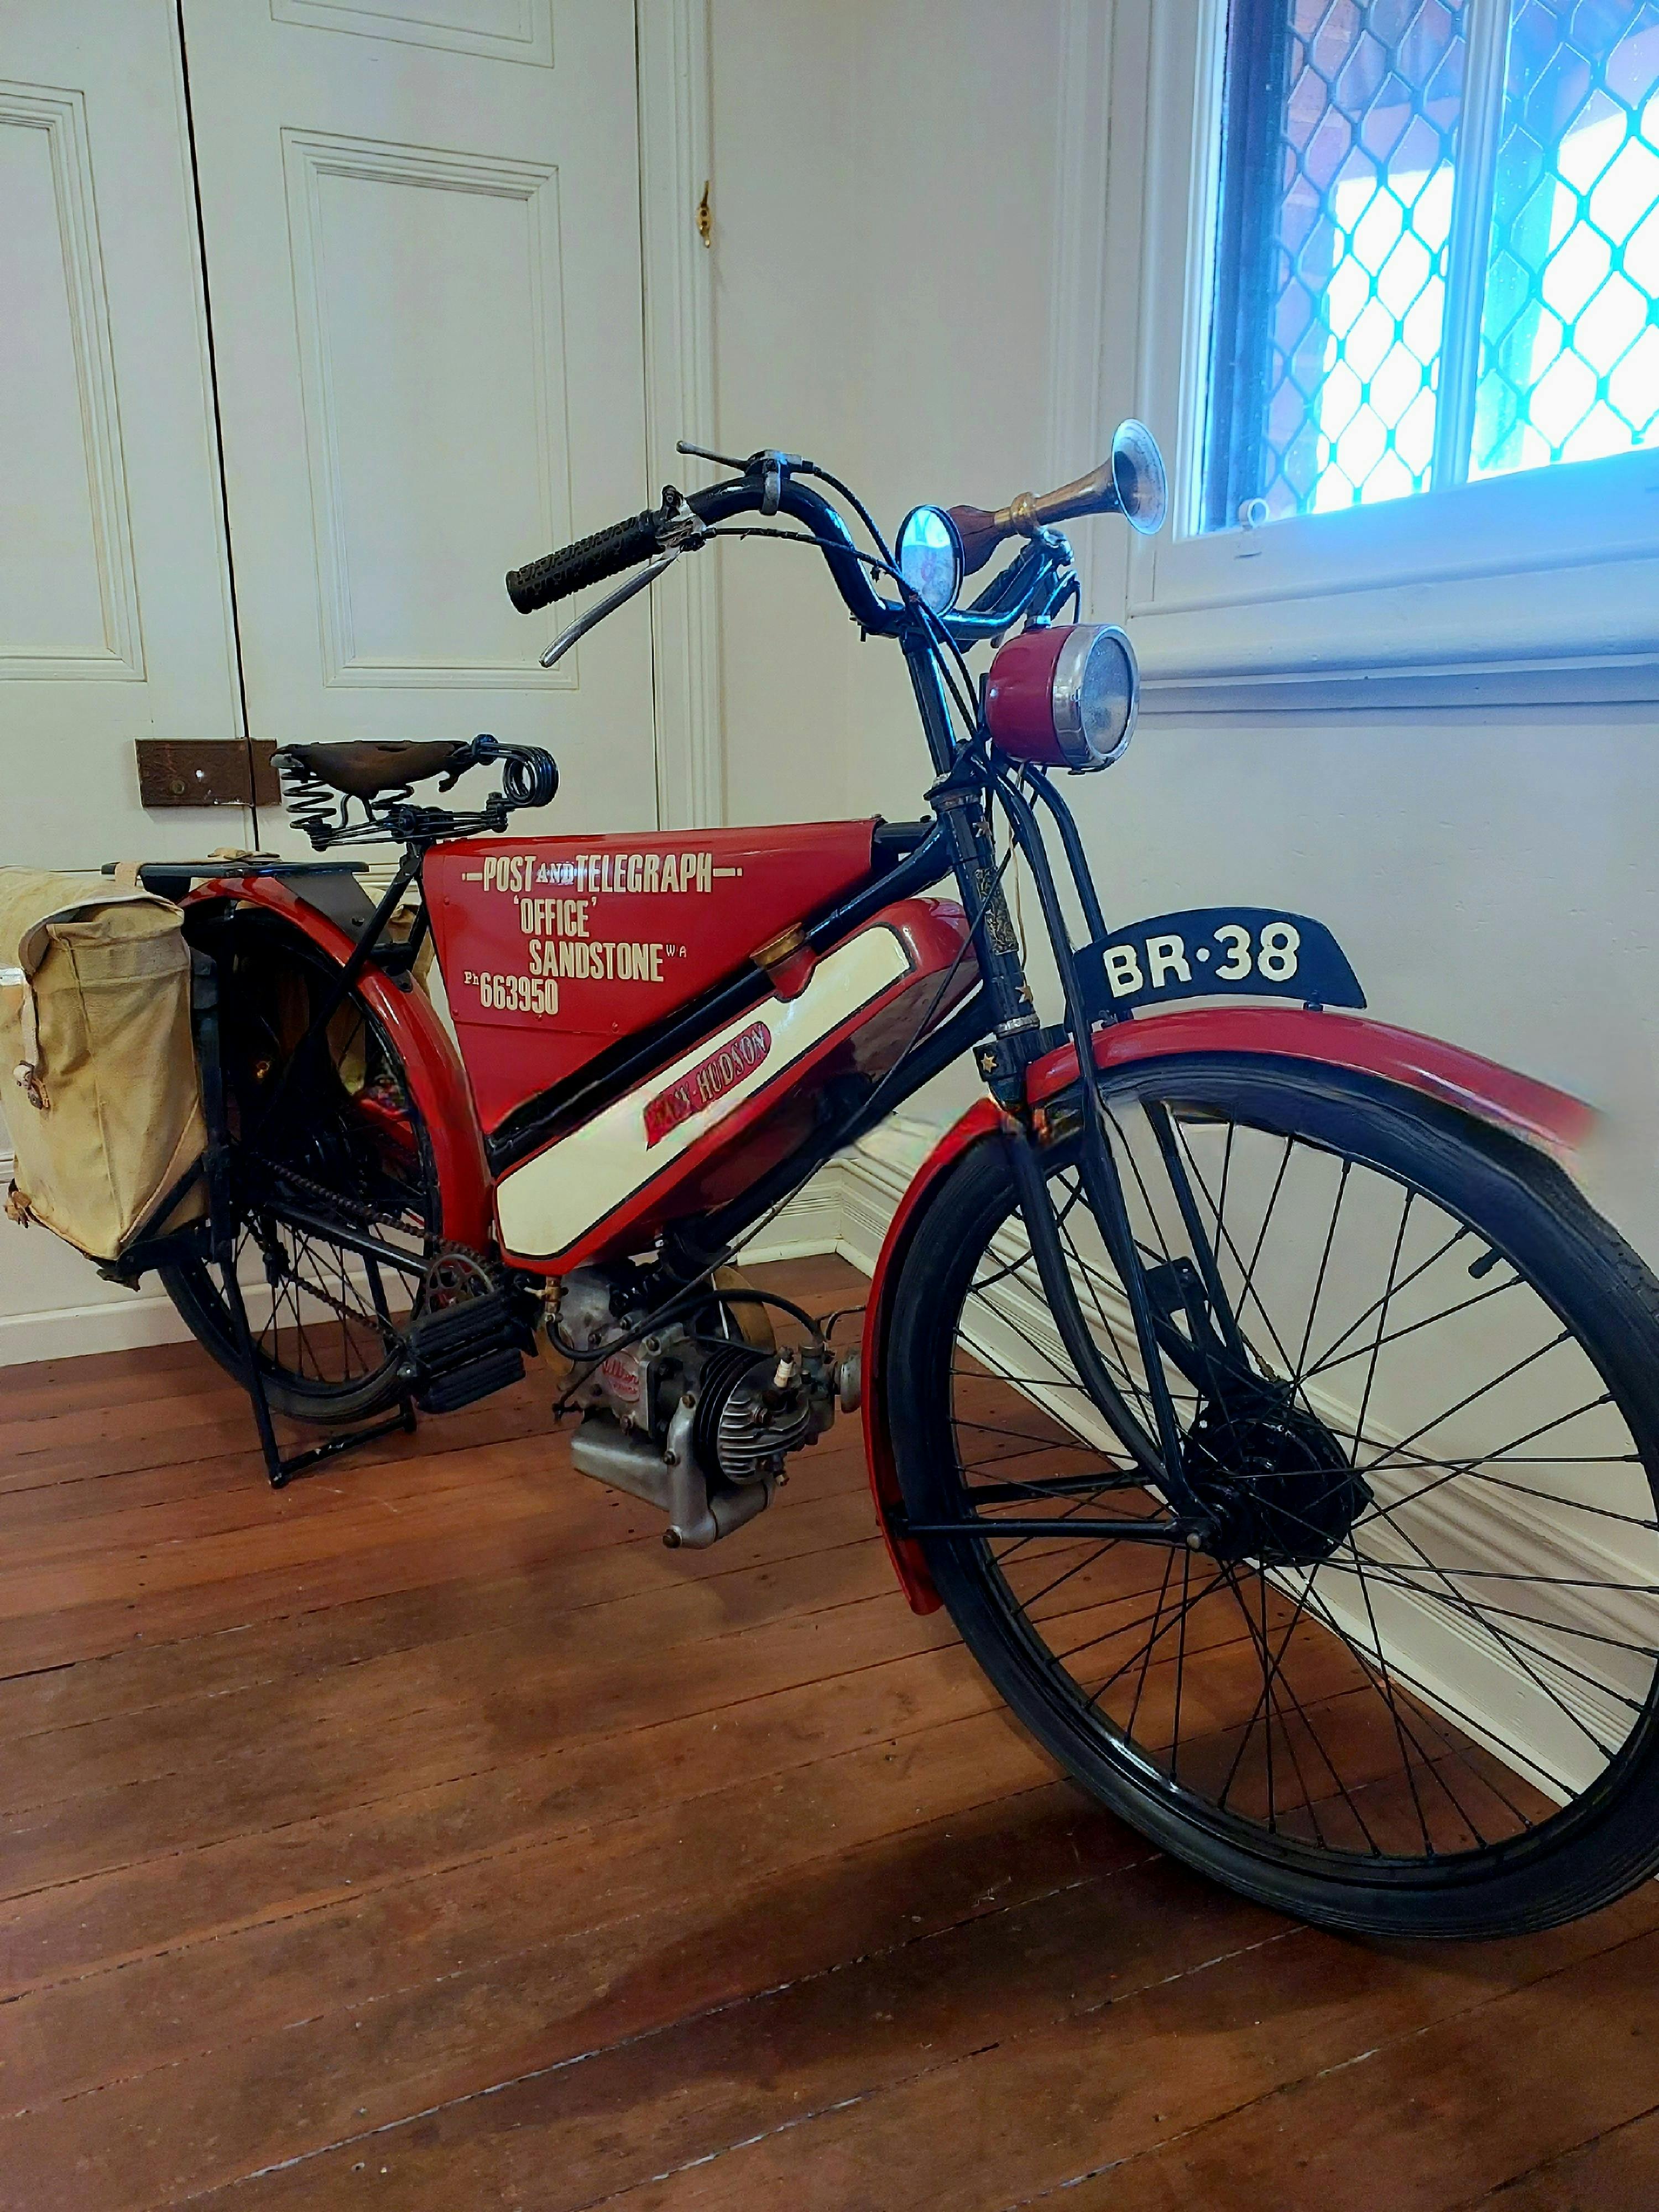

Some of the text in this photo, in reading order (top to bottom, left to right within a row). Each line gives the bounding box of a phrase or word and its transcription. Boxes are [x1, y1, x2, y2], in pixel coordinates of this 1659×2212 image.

[535, 862, 574, 885] AND
[529, 939, 664, 982] SANDSTONE
[464, 971, 559, 1015] Ph 663950
[696, 1024, 768, 1103] HUDSON
